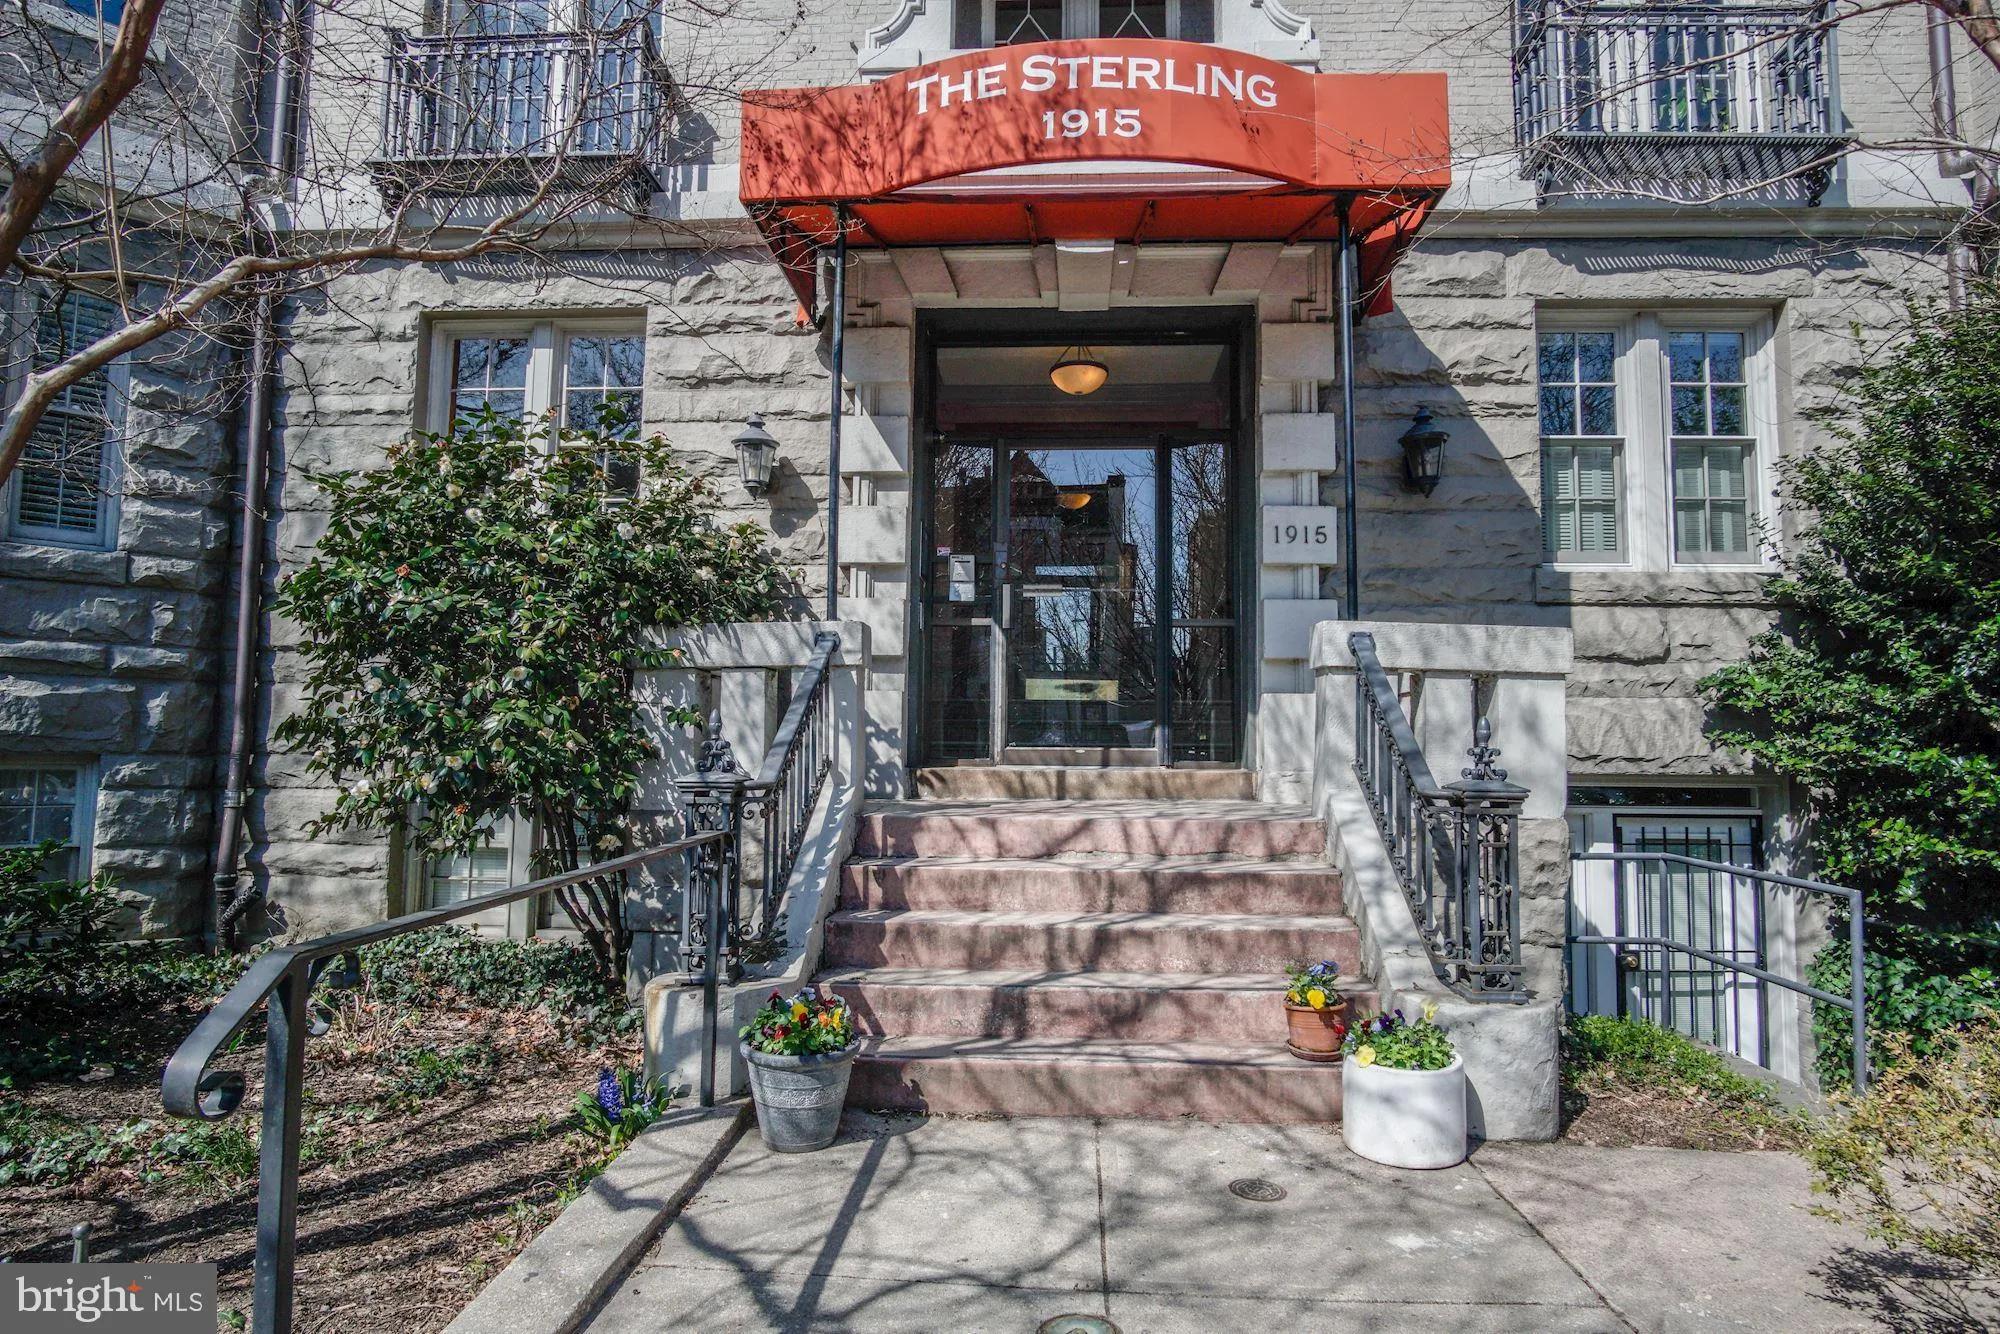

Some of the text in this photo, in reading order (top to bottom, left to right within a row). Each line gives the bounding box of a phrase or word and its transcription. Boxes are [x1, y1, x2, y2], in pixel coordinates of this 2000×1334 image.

[907, 54, 1278, 115] THE STERLING
[1043, 108, 1142, 139] 1915
[1274, 525, 1327, 544] 1915
